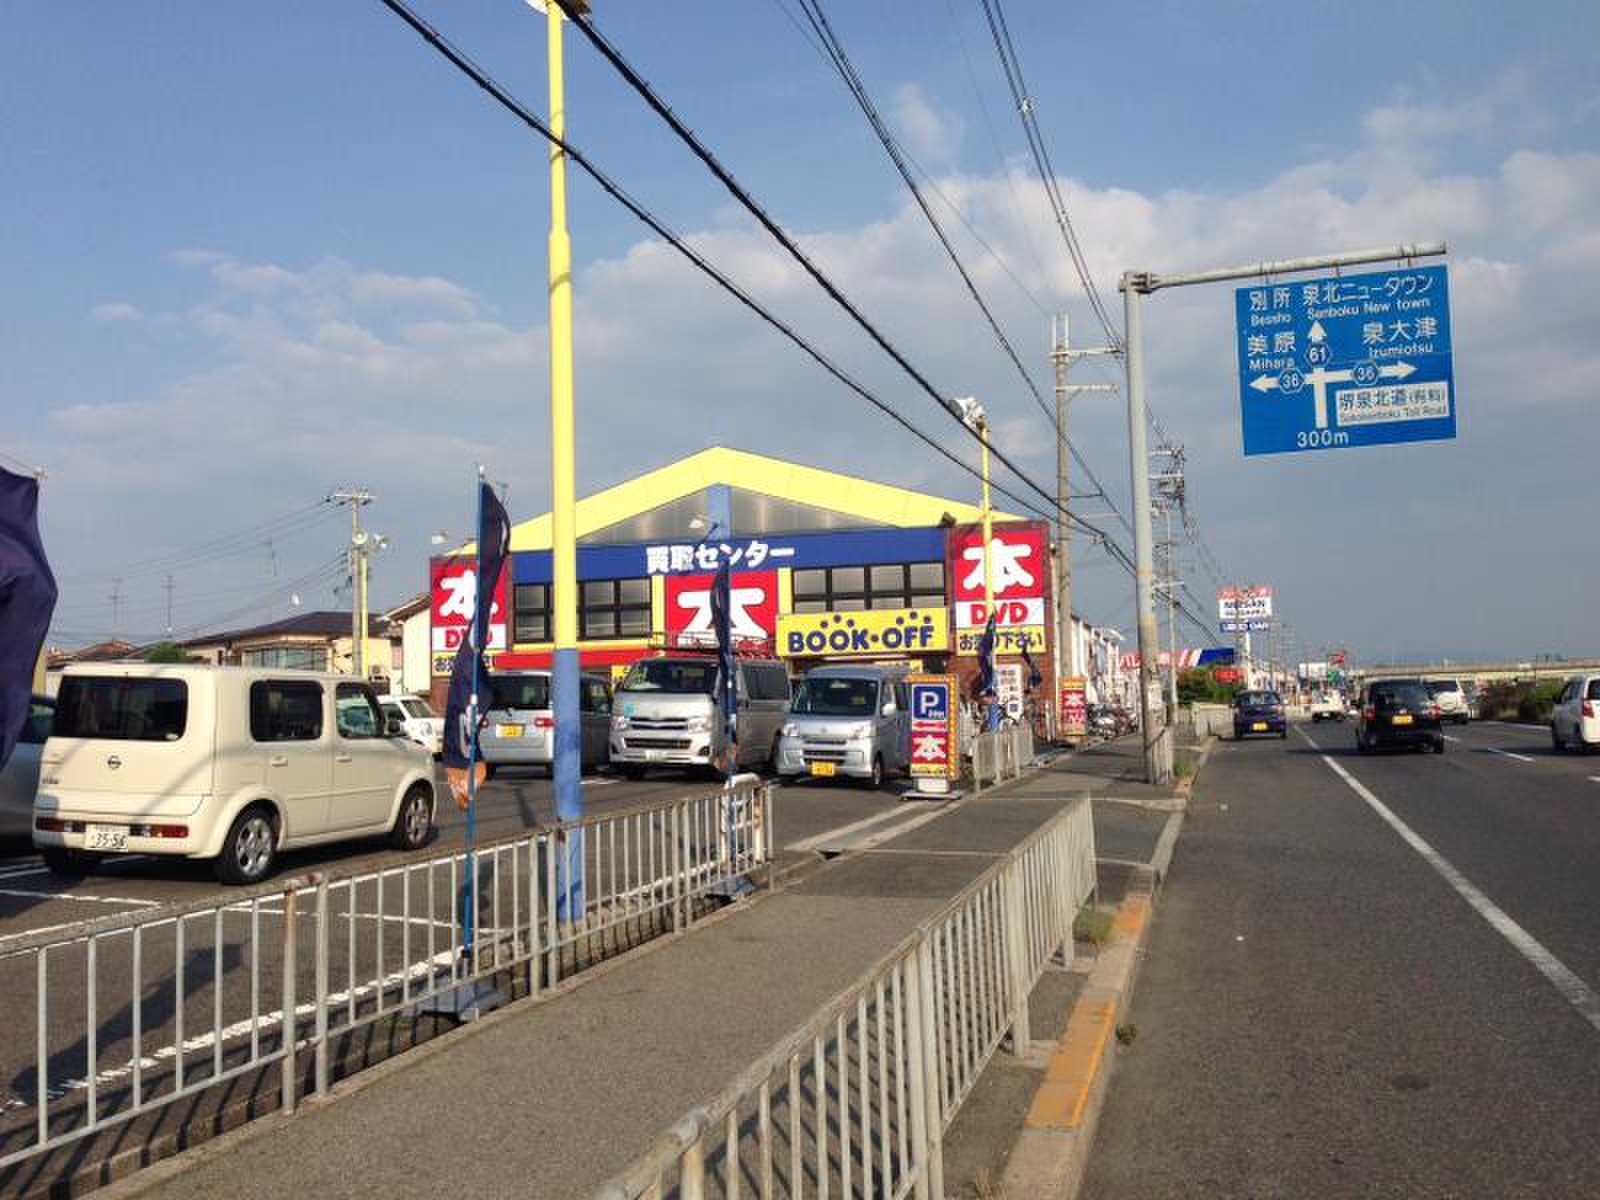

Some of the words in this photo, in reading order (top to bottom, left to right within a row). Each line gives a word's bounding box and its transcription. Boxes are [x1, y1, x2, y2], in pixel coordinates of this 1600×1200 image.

[1303, 276, 1433, 305] 泉北ニュータウン
[1364, 301, 1390, 314] New
[1363, 317, 1438, 345] 泉大津
[1248, 331, 1297, 357] 美原
[1309, 347, 1327, 362] 61
[1249, 357, 1296, 370] Mihara
[1297, 430, 1349, 448] 300m
[646, 540, 795, 574] 買取センター
[963, 538, 1034, 593] 本
[970, 602, 1028, 625] DVD
[959, 631, 1043, 651] おり下さい
[921, 691, 940, 715] P
[912, 734, 947, 761] 本
